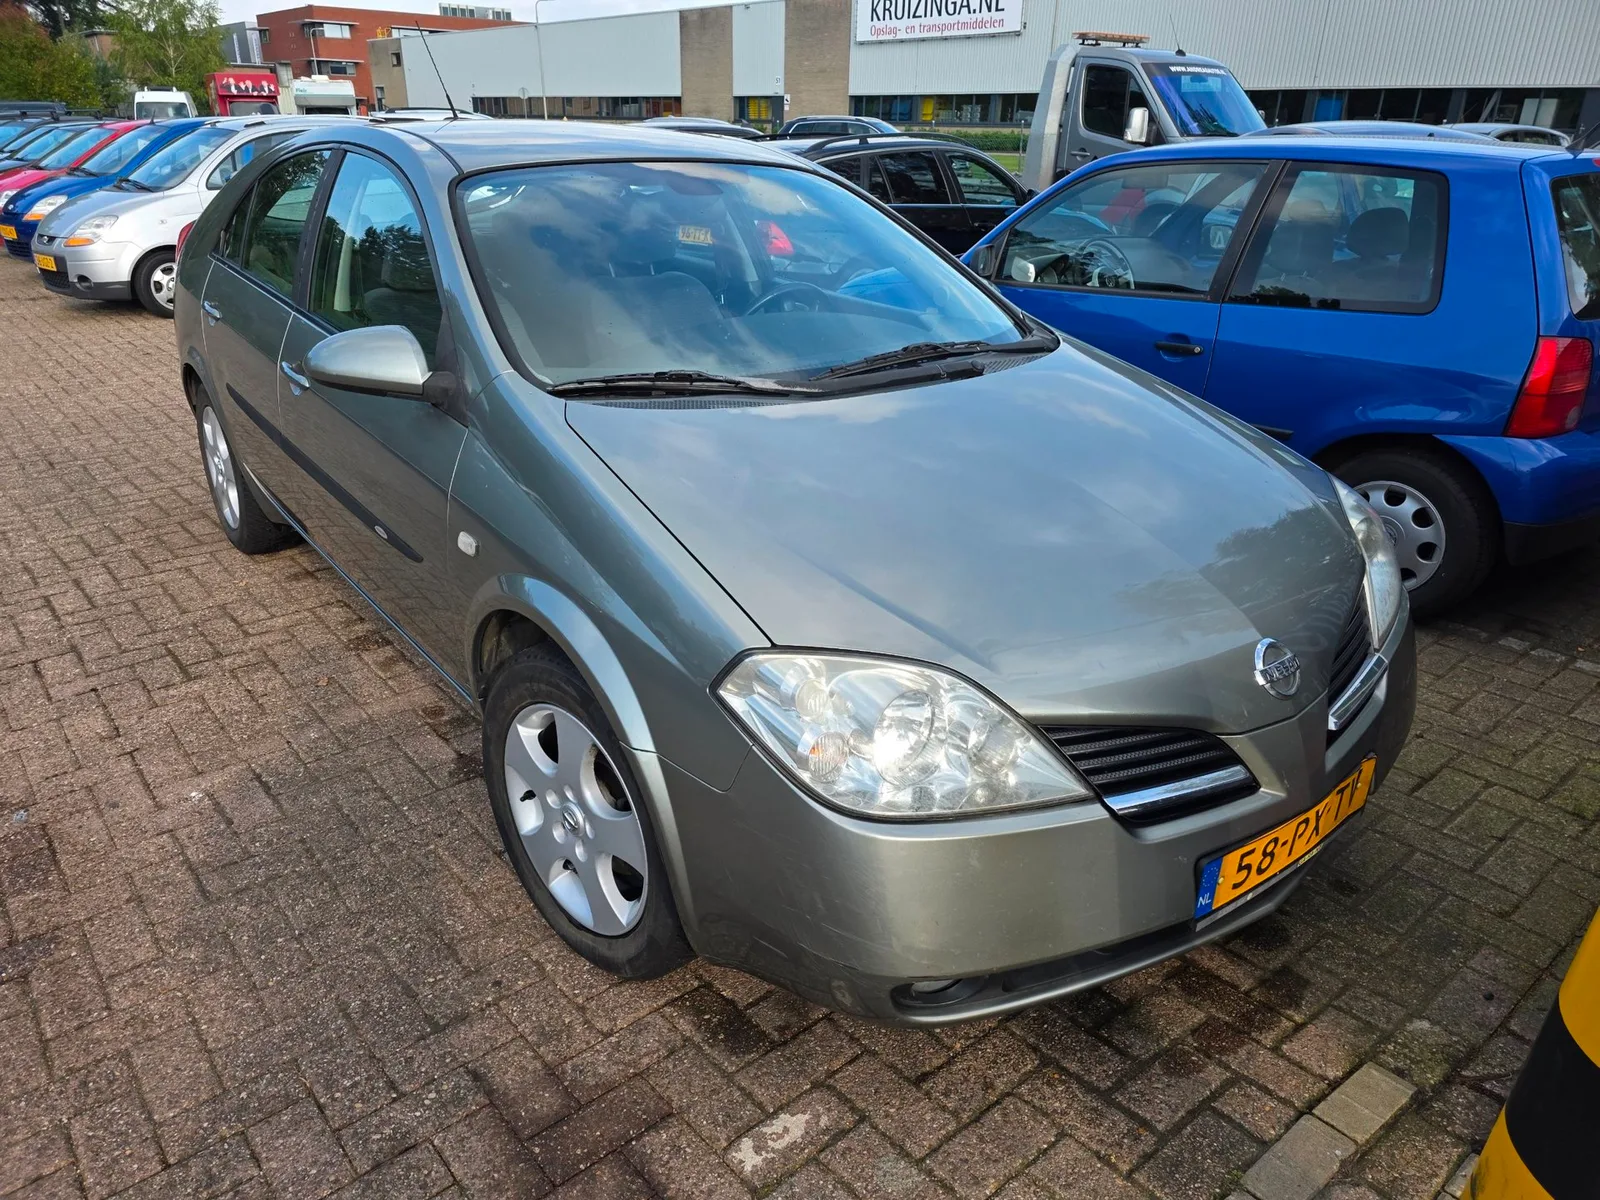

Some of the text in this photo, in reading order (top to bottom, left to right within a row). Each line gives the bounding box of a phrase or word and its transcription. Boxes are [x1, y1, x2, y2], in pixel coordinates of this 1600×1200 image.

[870, 16, 1005, 39] Opslag- en transportmiddelen
[1264, 656, 1300, 681] NISSAN
[1231, 768, 1363, 890] 58-PX-TV
[1197, 892, 1212, 908] NL
